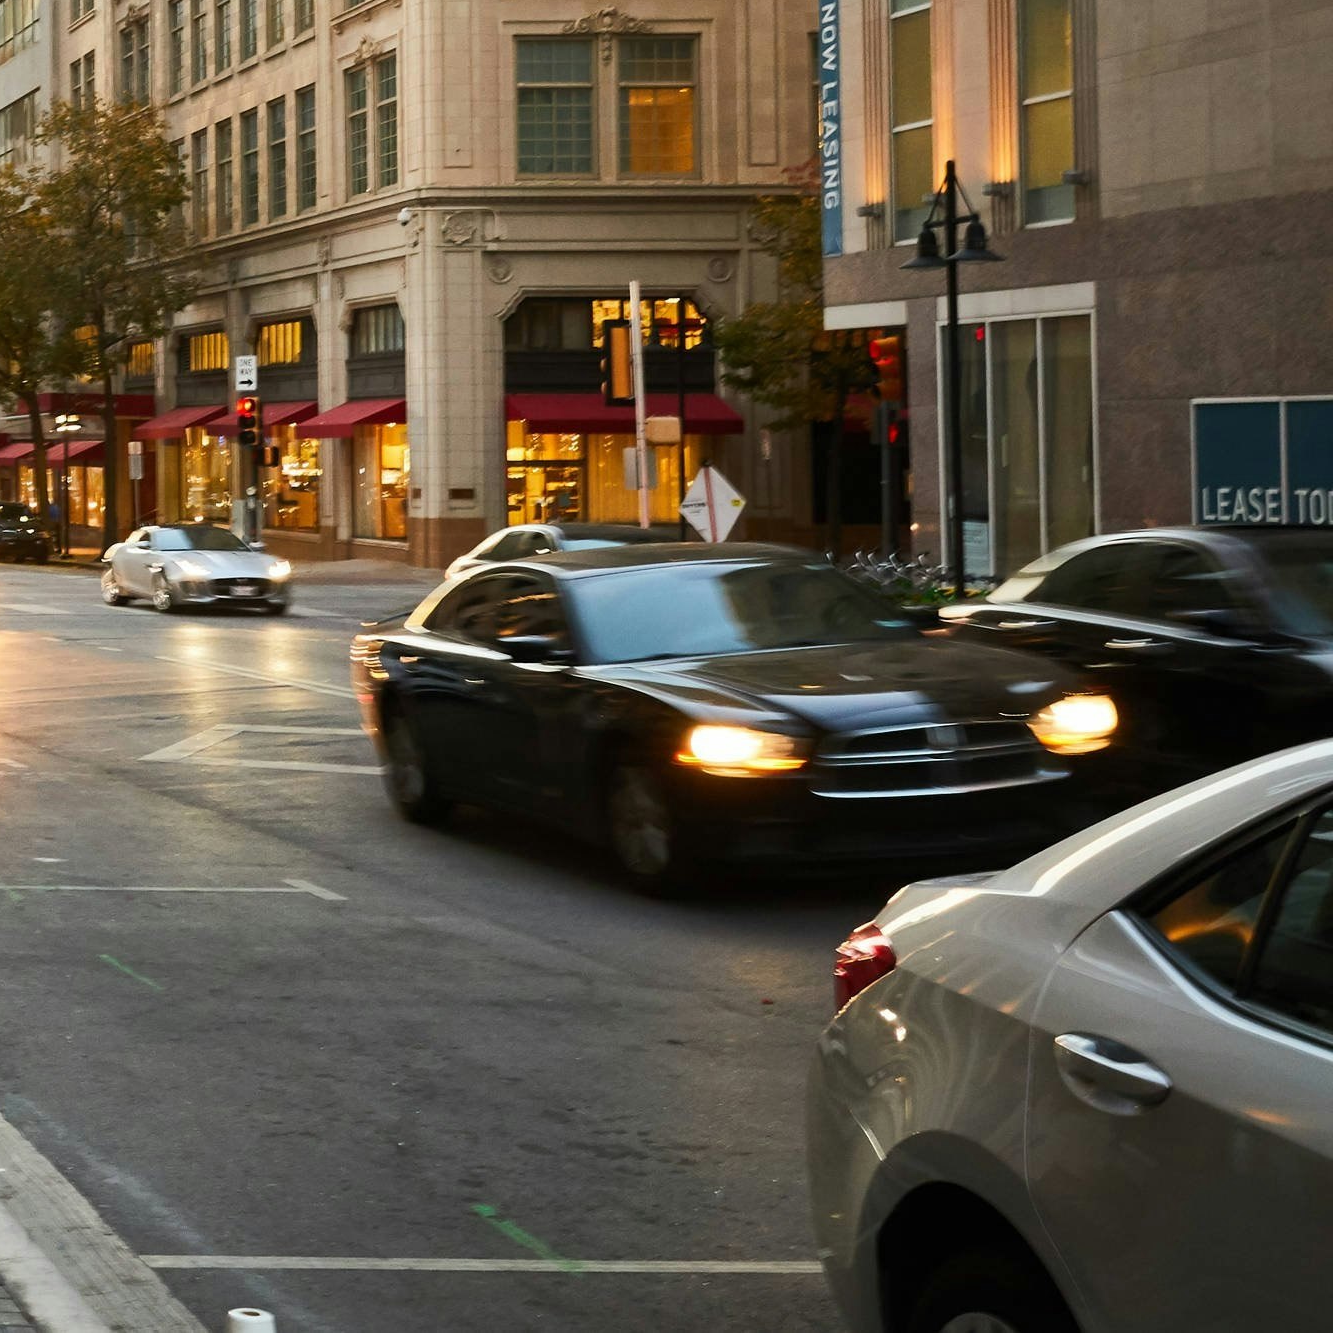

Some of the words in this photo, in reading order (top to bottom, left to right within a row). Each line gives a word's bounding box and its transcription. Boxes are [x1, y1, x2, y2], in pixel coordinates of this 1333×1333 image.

[820, 2, 837, 71] NOW
[821, 82, 840, 210] LEASING
[1201, 487, 1280, 522] LEASE
